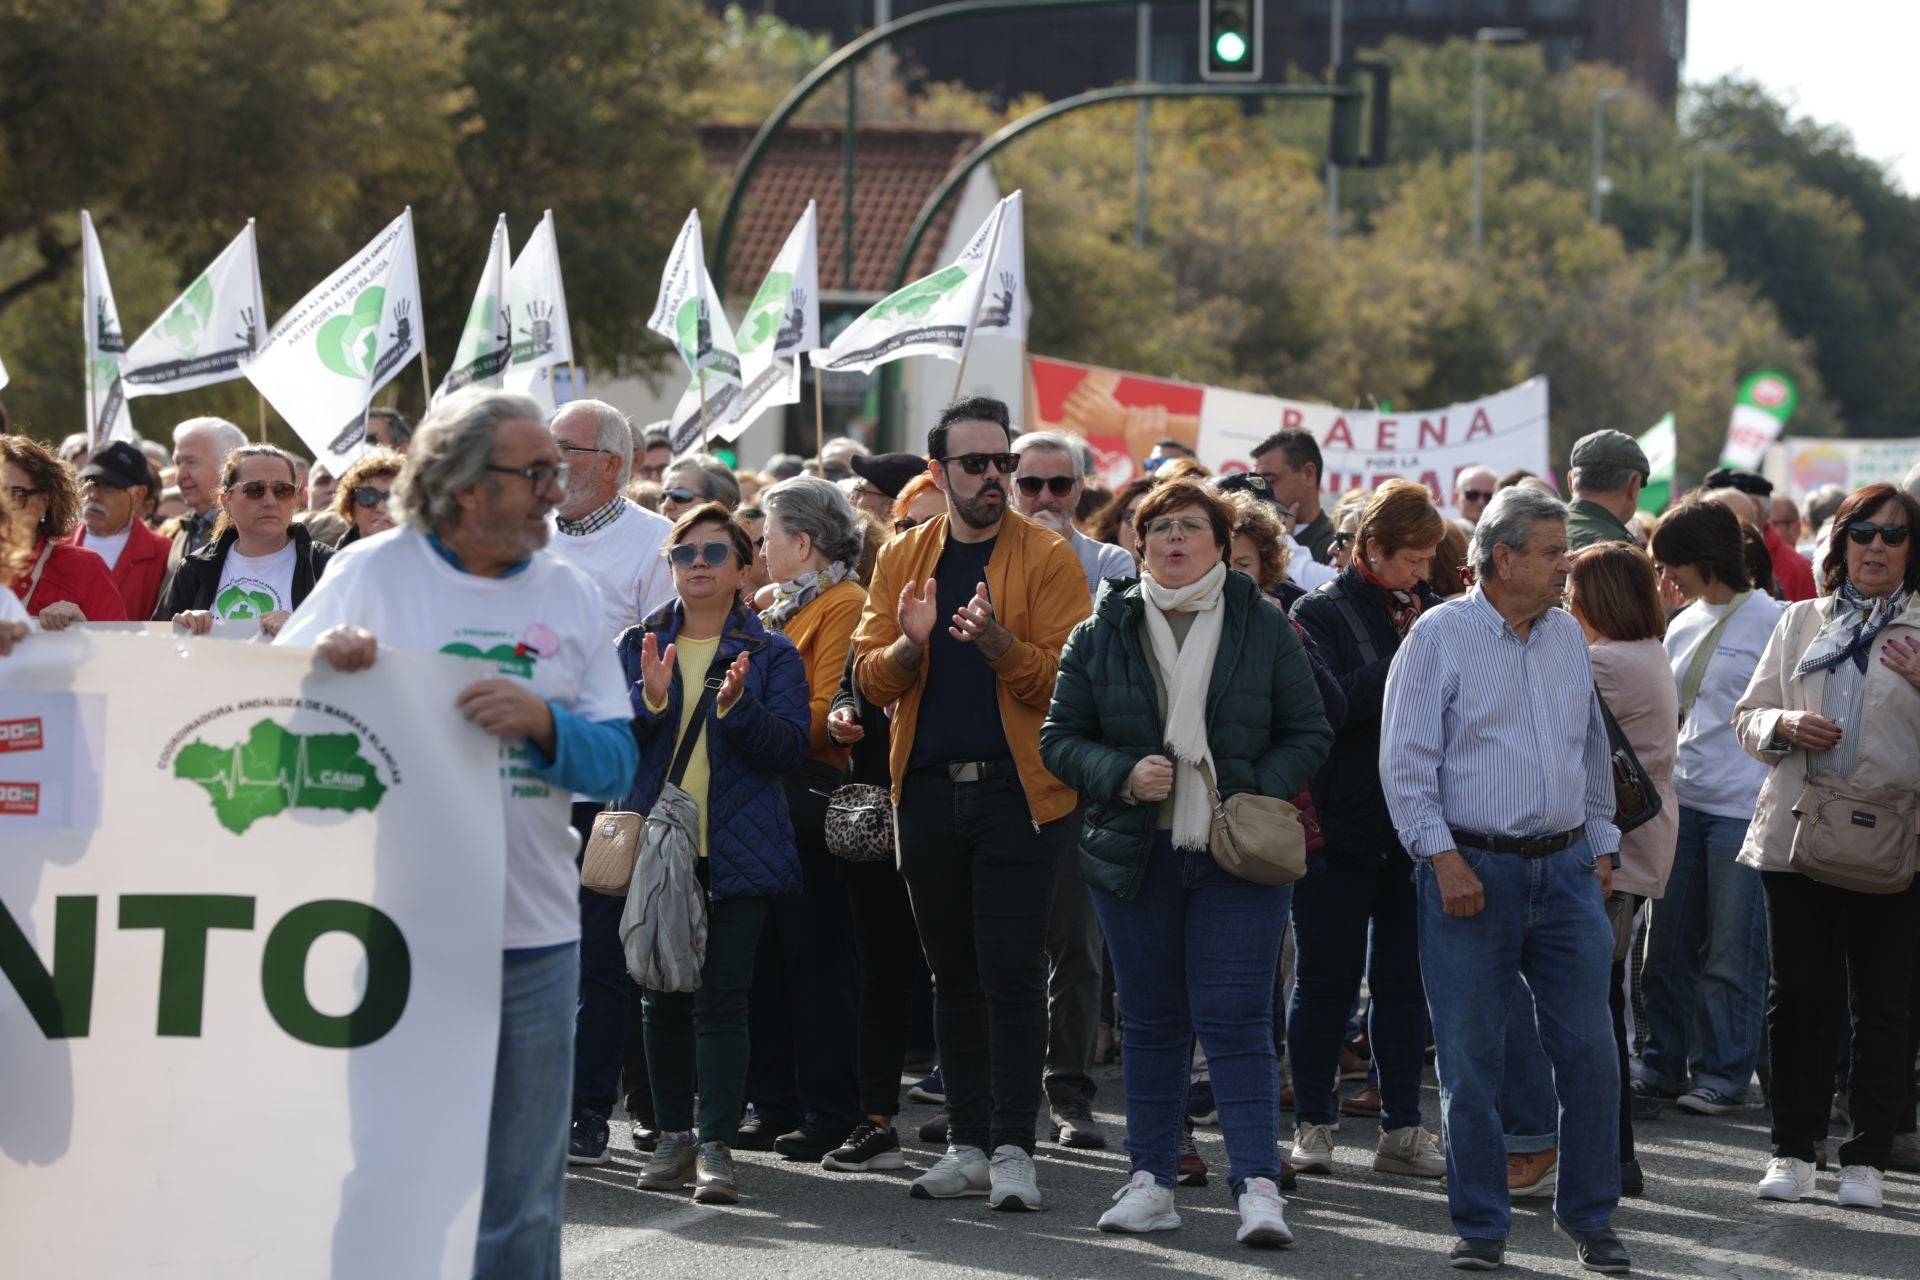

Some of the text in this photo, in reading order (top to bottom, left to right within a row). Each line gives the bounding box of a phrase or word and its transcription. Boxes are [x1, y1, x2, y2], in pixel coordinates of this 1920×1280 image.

[1366, 456, 1420, 468] POR LA
[157, 697, 402, 785] COORDINADORA ANDALUZA DE MAREAS BLANCAS
